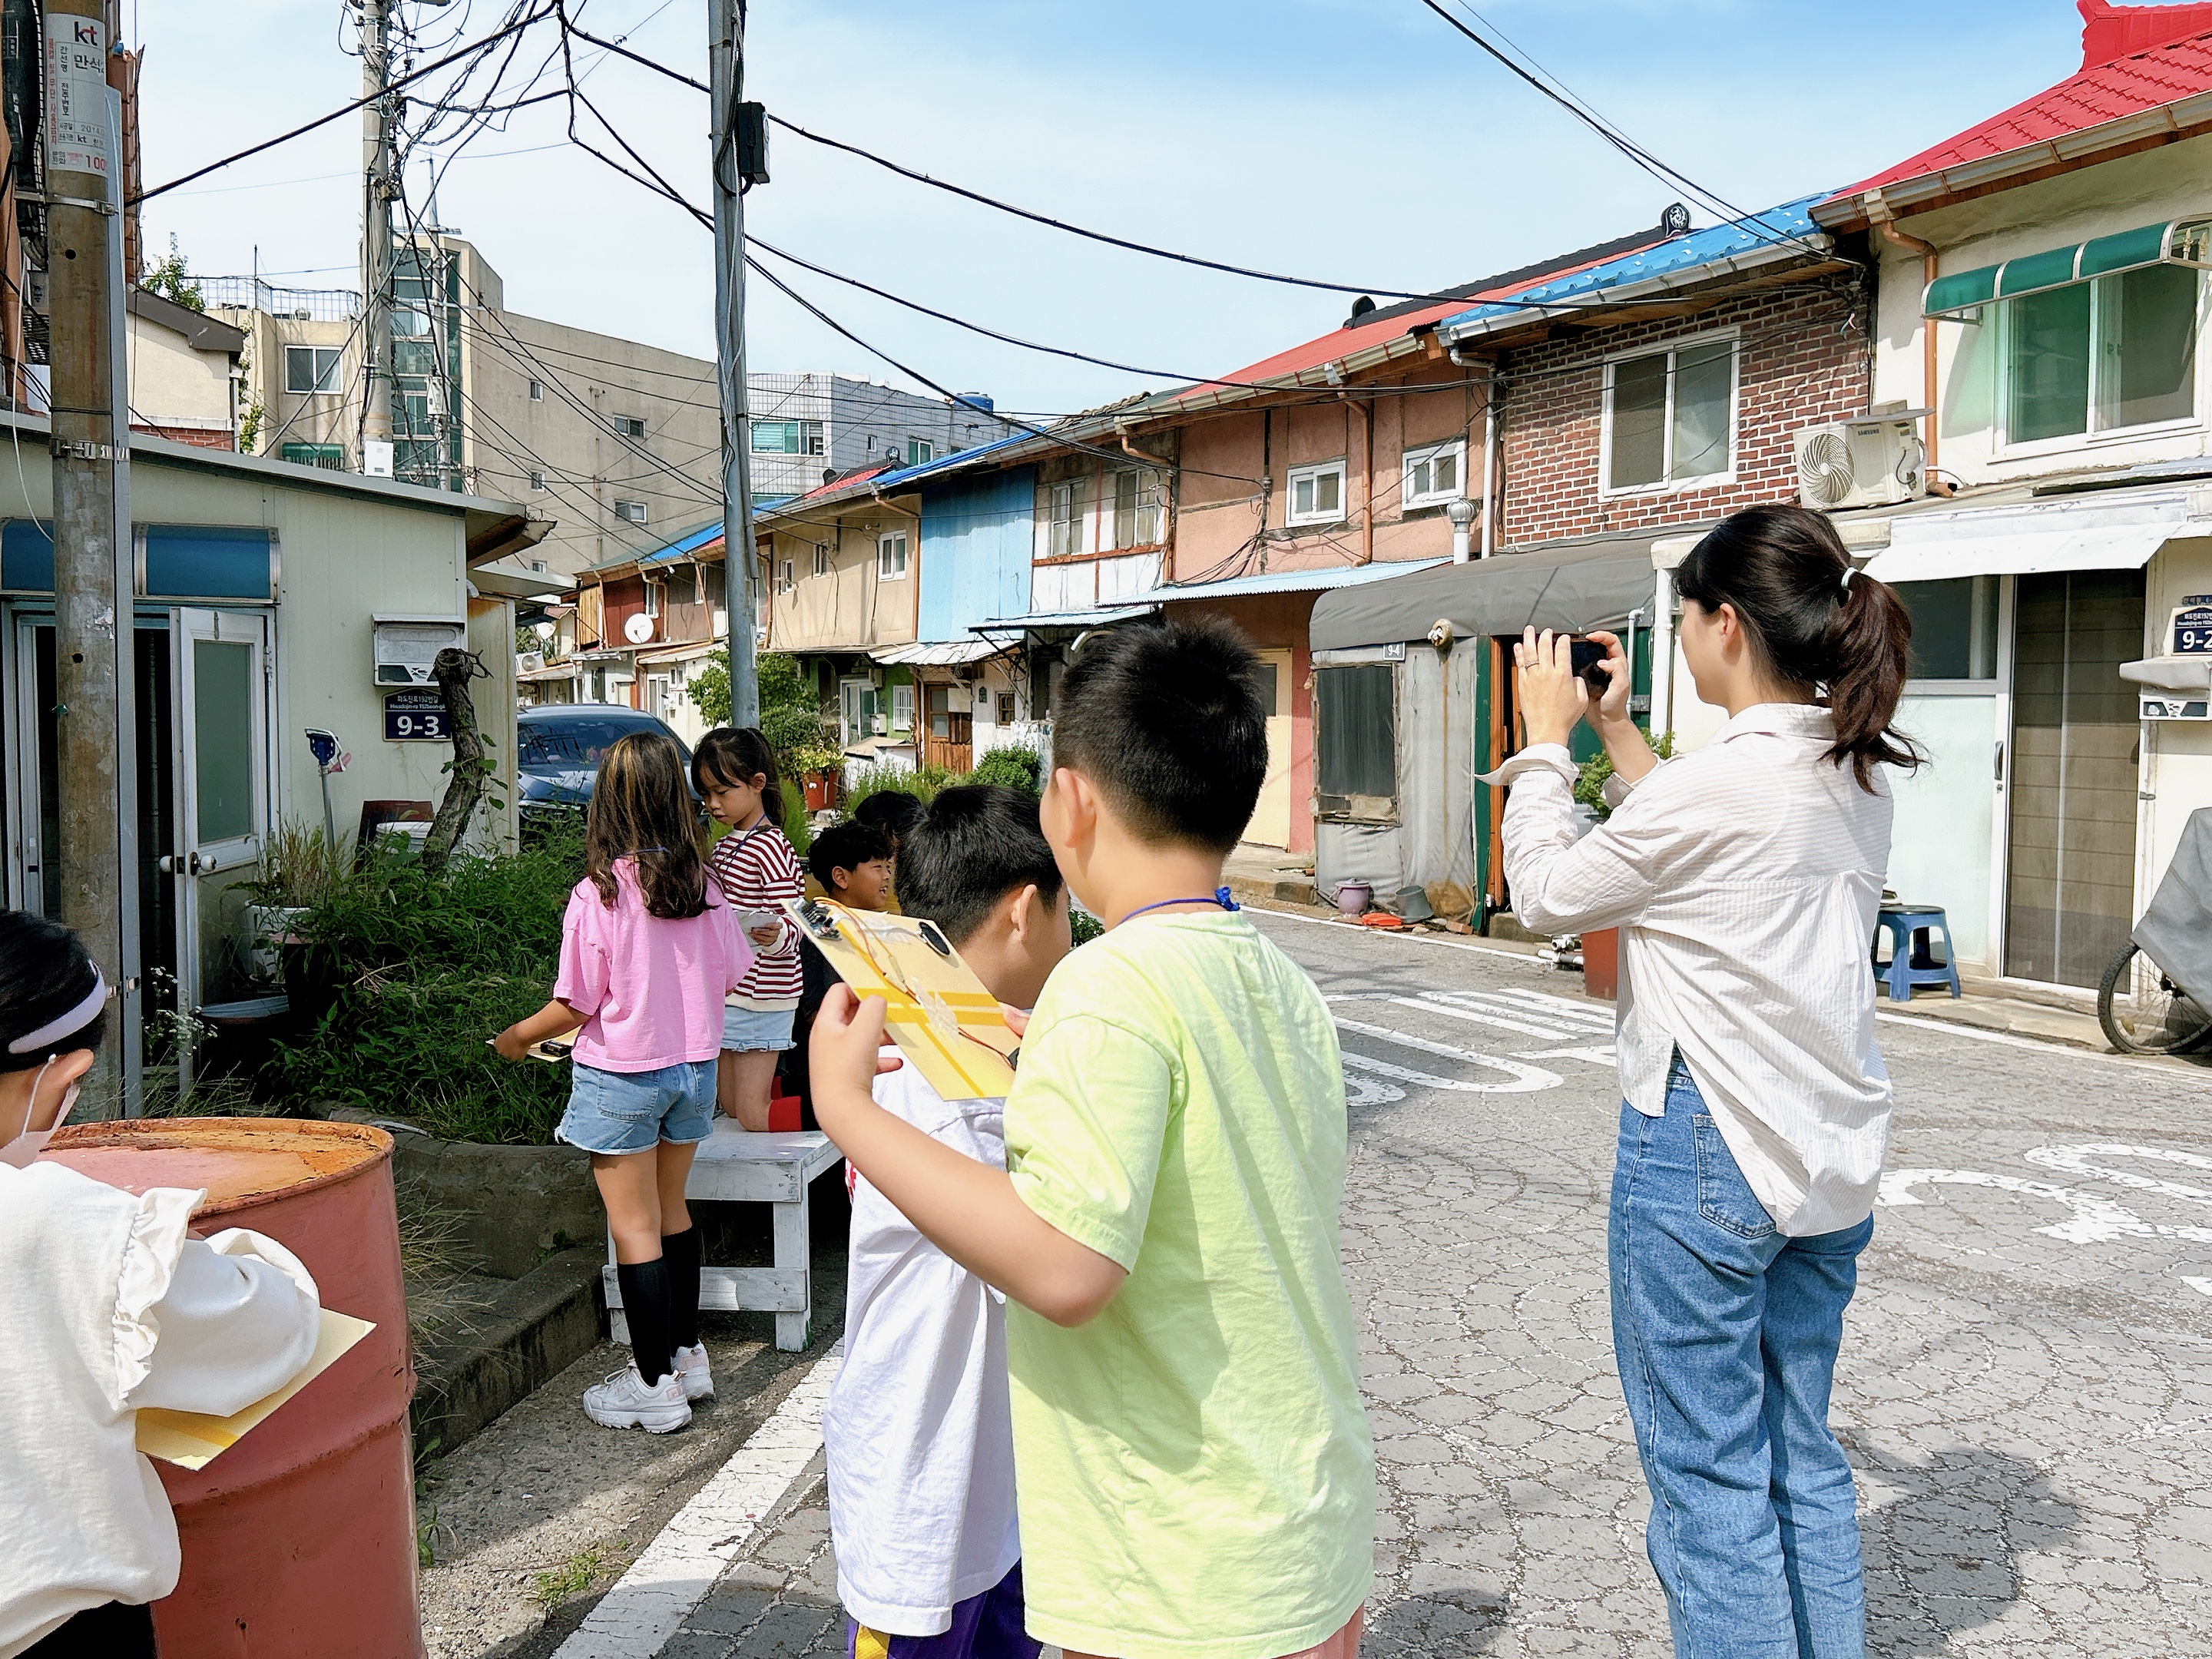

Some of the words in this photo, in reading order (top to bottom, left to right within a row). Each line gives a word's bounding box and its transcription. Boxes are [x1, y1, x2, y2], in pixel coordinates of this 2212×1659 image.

[74, 22, 98, 46] kt
[74, 55, 104, 73] 만석
[77, 134, 88, 144] kt
[1387, 644, 1400, 657] 9-4
[397, 715, 439, 736] 9-3
